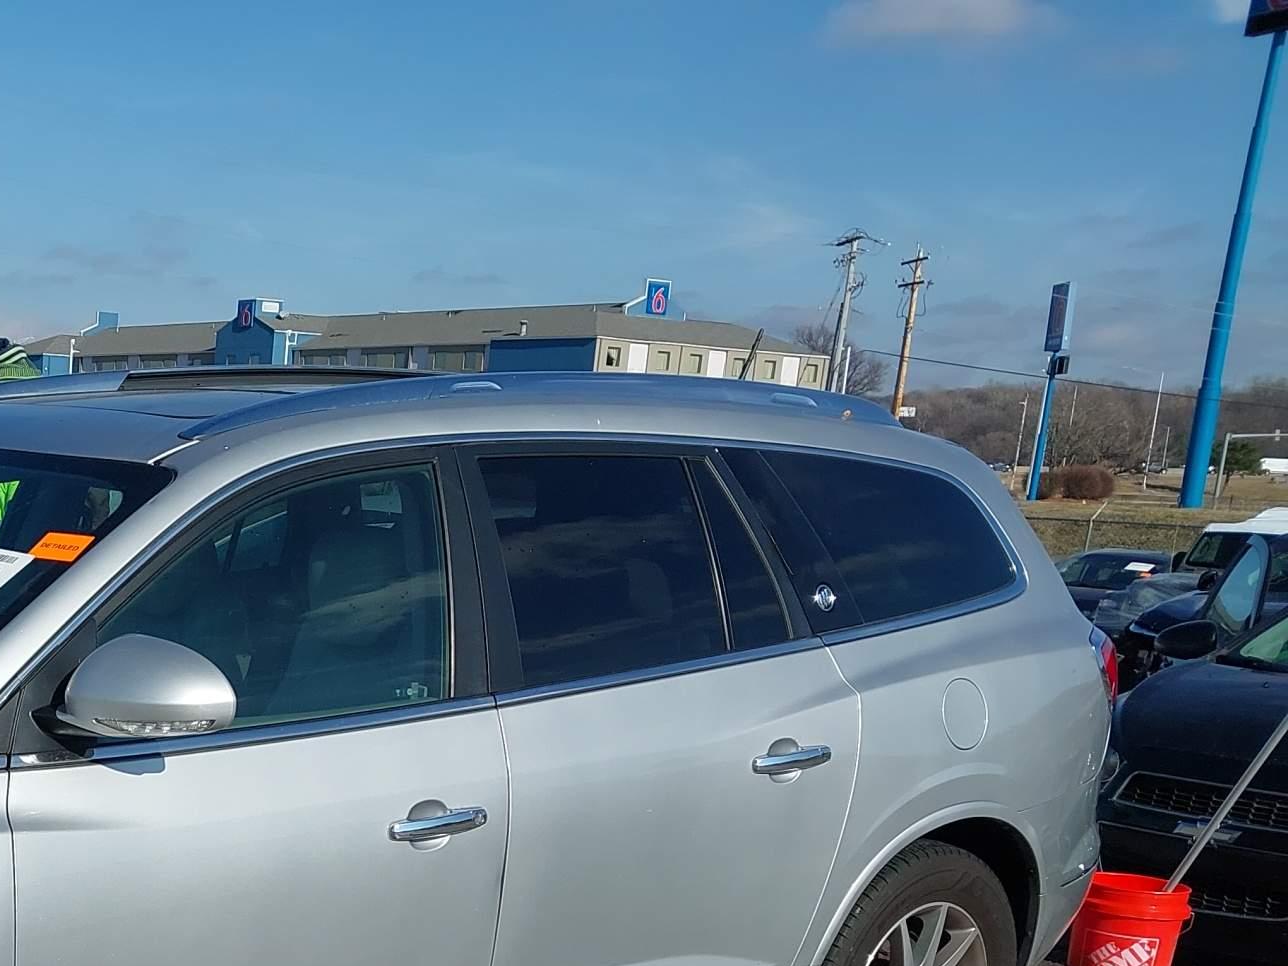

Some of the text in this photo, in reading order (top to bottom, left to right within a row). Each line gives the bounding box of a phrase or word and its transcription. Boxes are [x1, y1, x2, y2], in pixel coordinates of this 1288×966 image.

[652, 286, 665, 314] 6
[40, 542, 80, 551] DETAILED
[1089, 941, 1120, 964] THE
